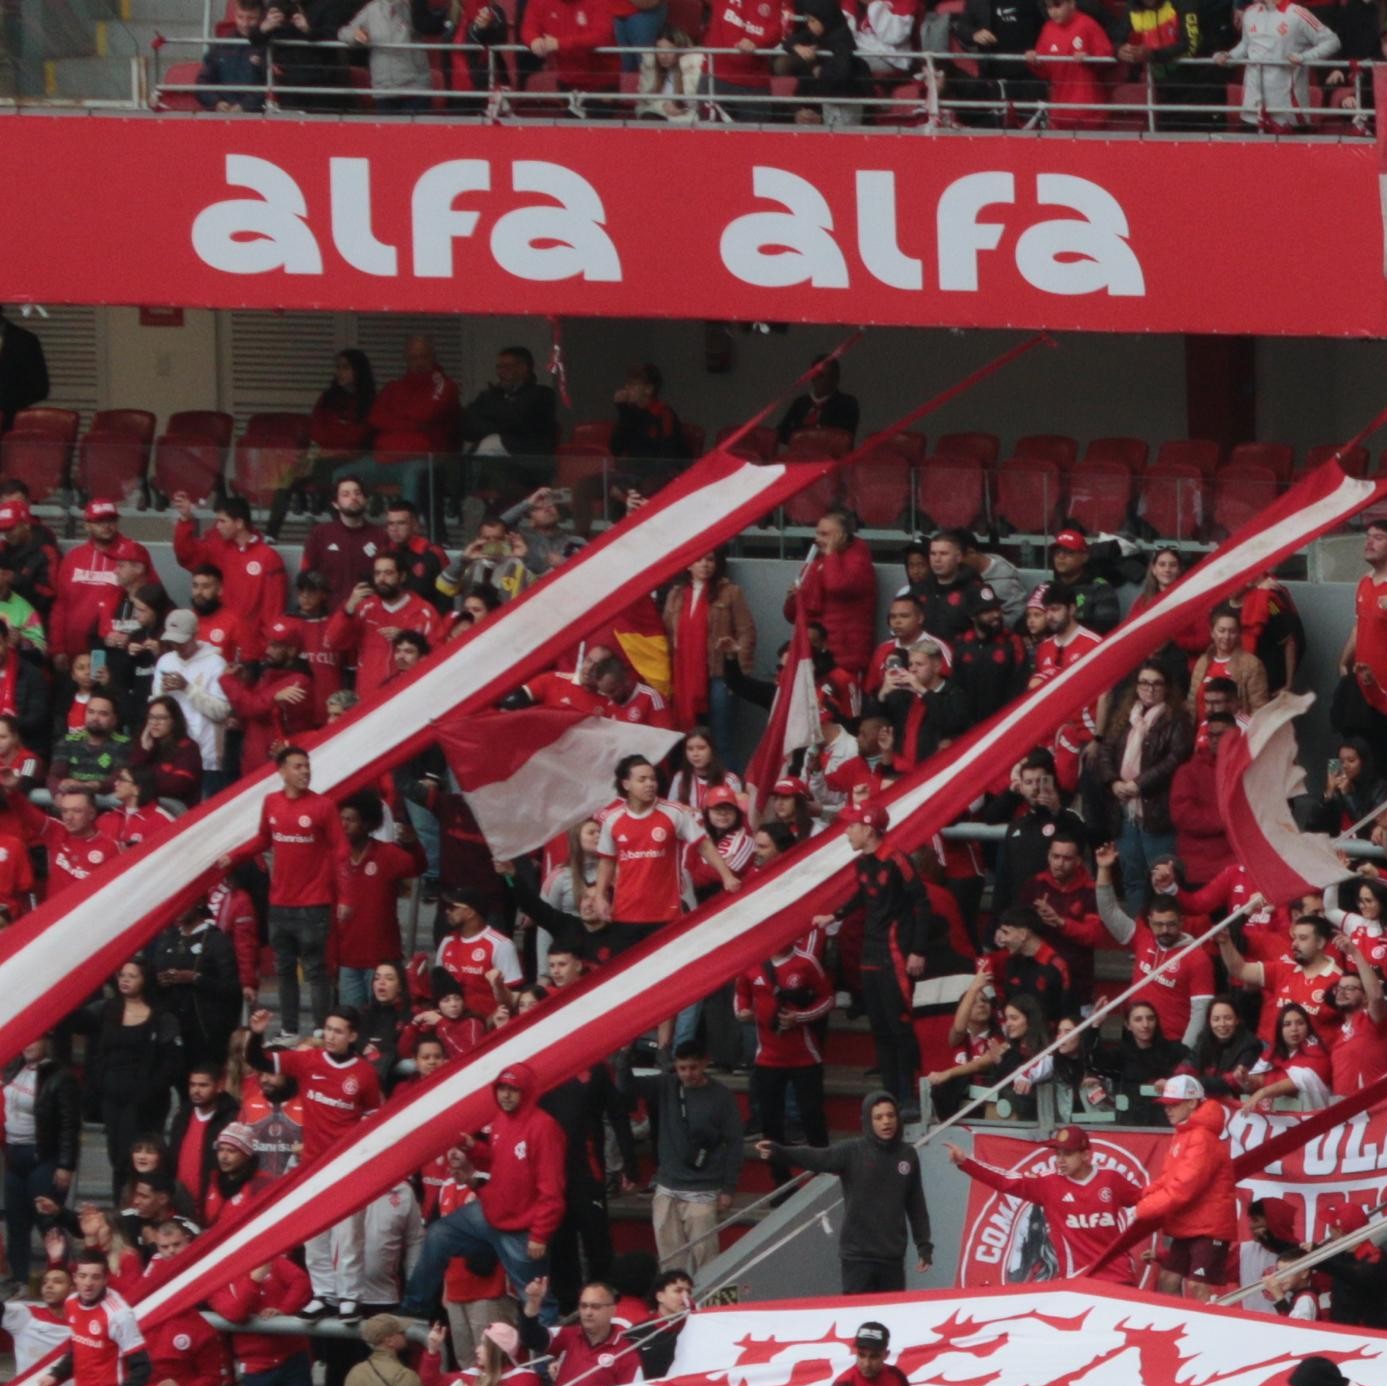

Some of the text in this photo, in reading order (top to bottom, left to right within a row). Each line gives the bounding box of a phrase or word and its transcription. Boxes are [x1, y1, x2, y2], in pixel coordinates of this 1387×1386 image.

[190, 153, 623, 284] alfa
[719, 165, 1146, 297] alfa
[1064, 1211, 1114, 1230] alfa
